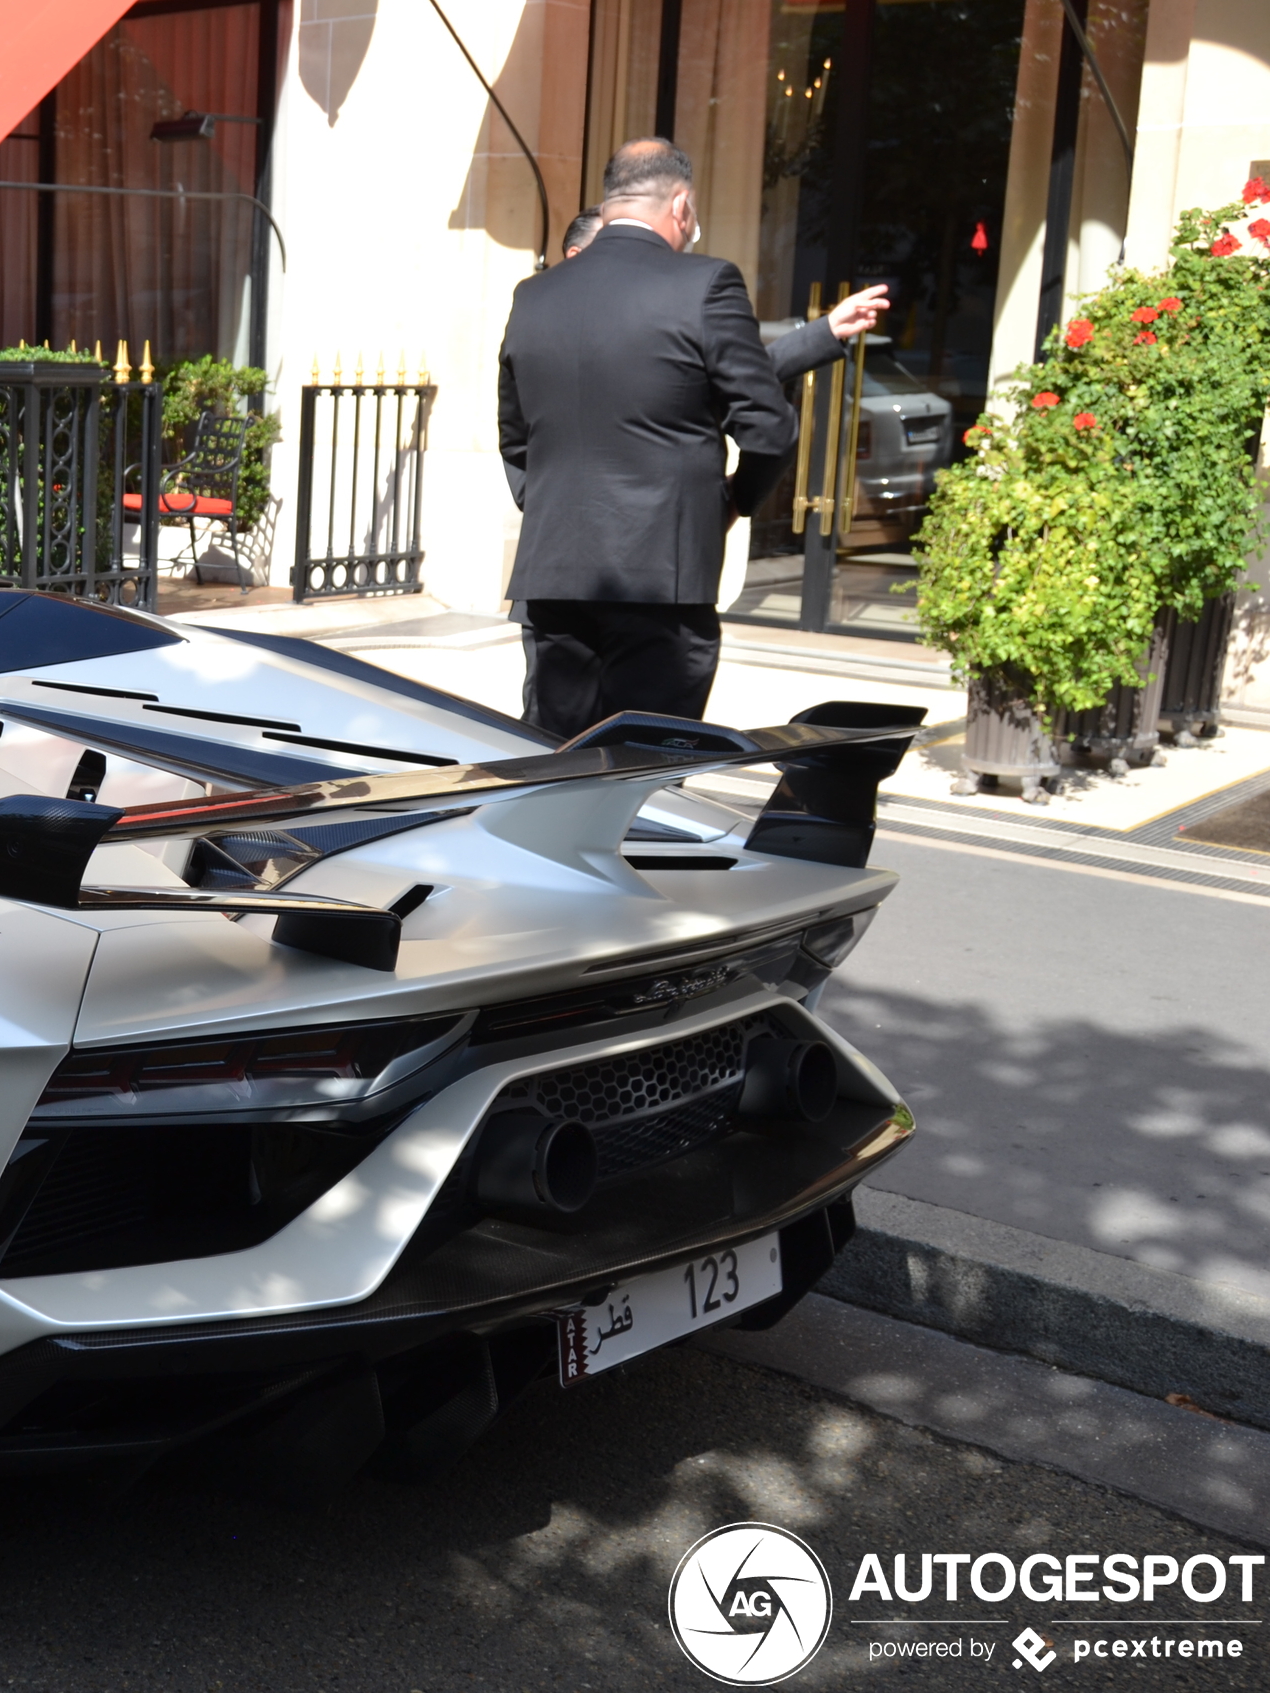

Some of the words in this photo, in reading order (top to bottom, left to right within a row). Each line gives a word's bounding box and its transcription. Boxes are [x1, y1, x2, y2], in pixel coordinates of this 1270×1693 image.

[683, 1248, 740, 1320] 123
[564, 1312, 578, 1379] ATAR
[589, 1294, 634, 1356] قطر
